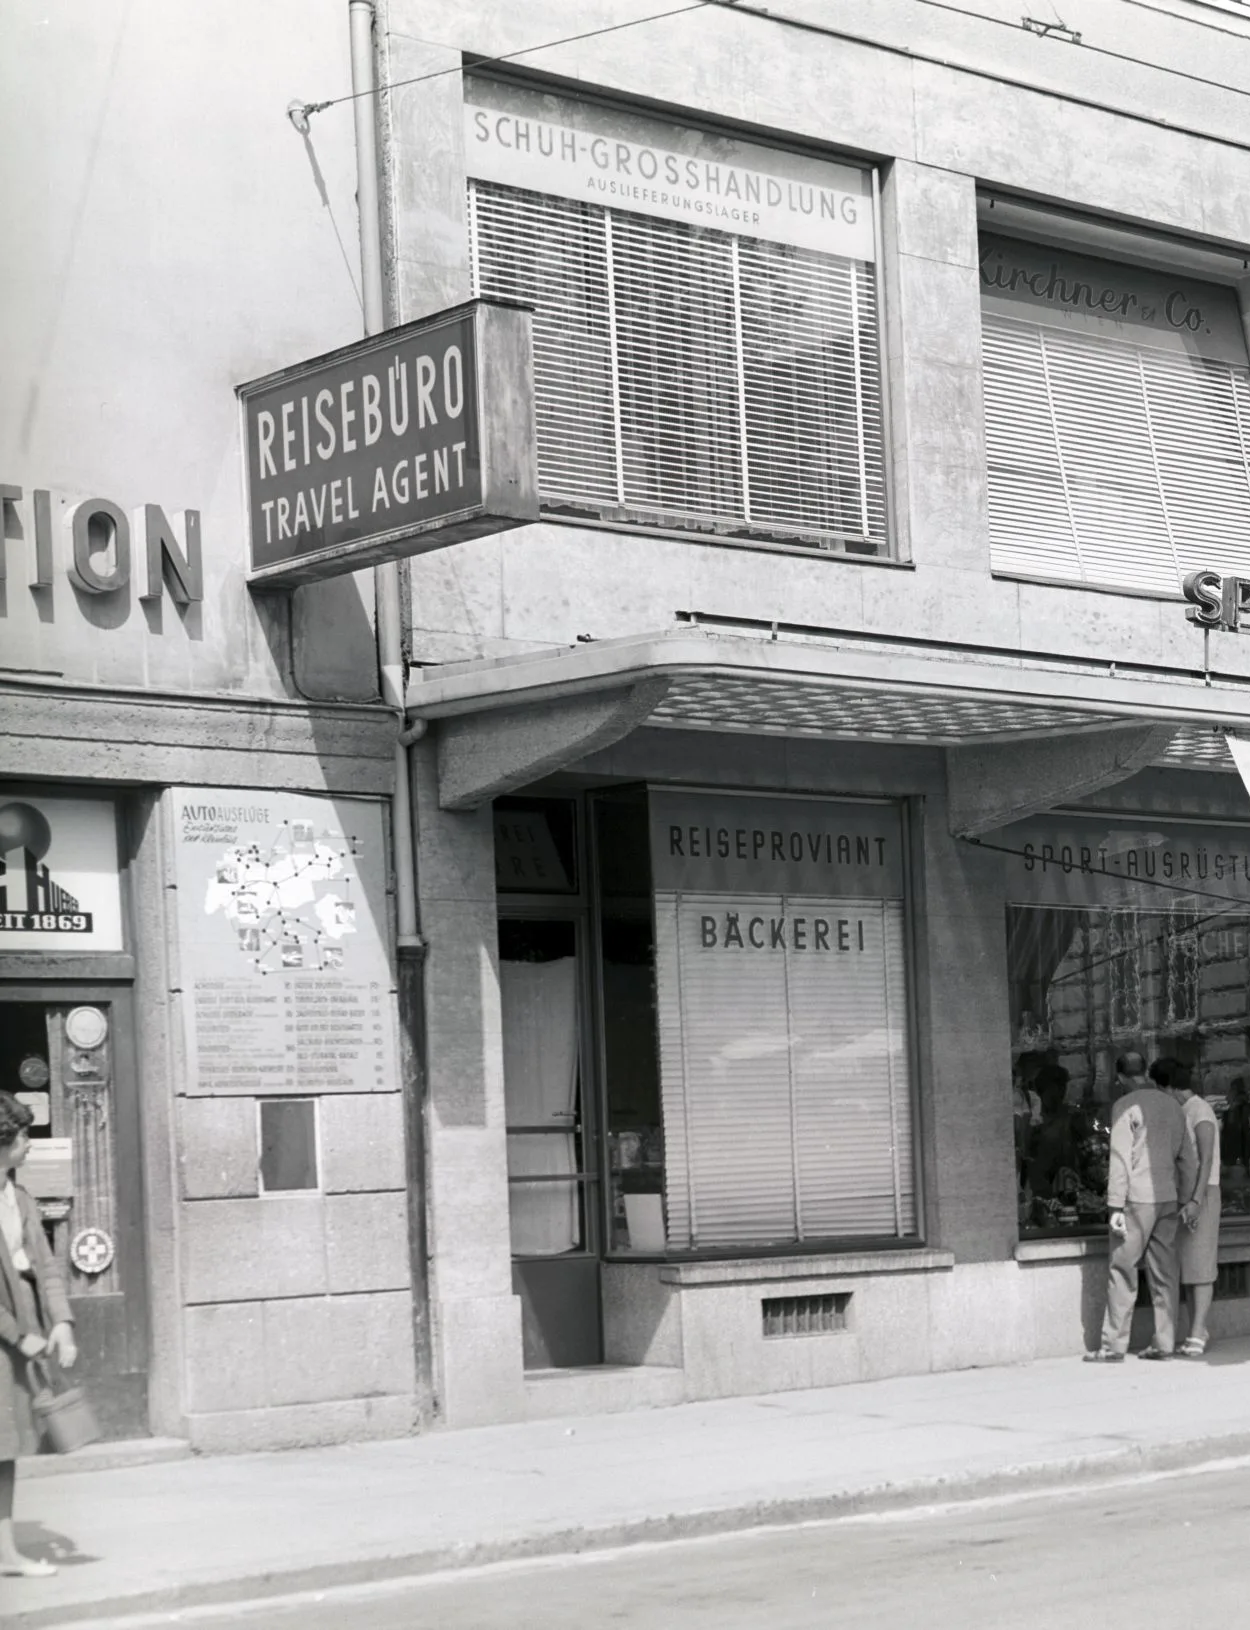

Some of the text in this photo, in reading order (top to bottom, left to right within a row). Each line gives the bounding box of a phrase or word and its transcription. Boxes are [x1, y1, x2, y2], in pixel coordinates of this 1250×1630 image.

[475, 111, 858, 225] SCHUH-GROSSHANDLUNG
[587, 176, 760, 225] AUSLIEFERUNGSLAGER
[1165, 290, 1211, 335] Co.
[257, 345, 464, 480] REISEBÜRO
[261, 441, 467, 544] TRAVEL AGENT
[669, 825, 886, 867] REISEPROVIANT
[30, 914, 87, 931] 1869
[701, 912, 865, 952] BÄCKEREI
